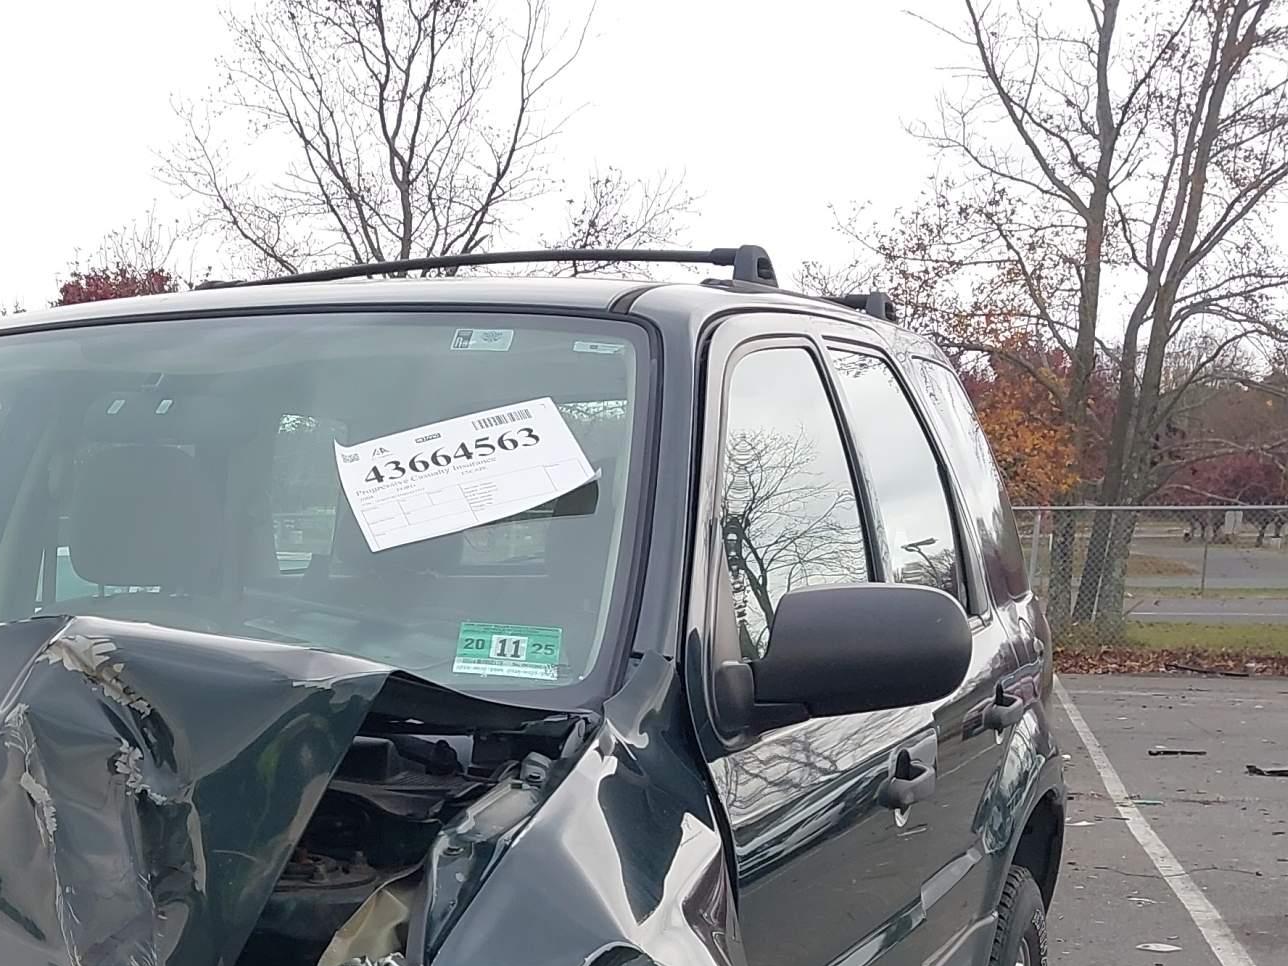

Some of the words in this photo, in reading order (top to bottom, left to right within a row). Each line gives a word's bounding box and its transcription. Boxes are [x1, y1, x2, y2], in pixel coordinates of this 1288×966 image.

[364, 427, 541, 483] 43664563
[463, 638, 485, 650] 20
[496, 638, 521, 659] 11
[531, 643, 555, 656] 25
